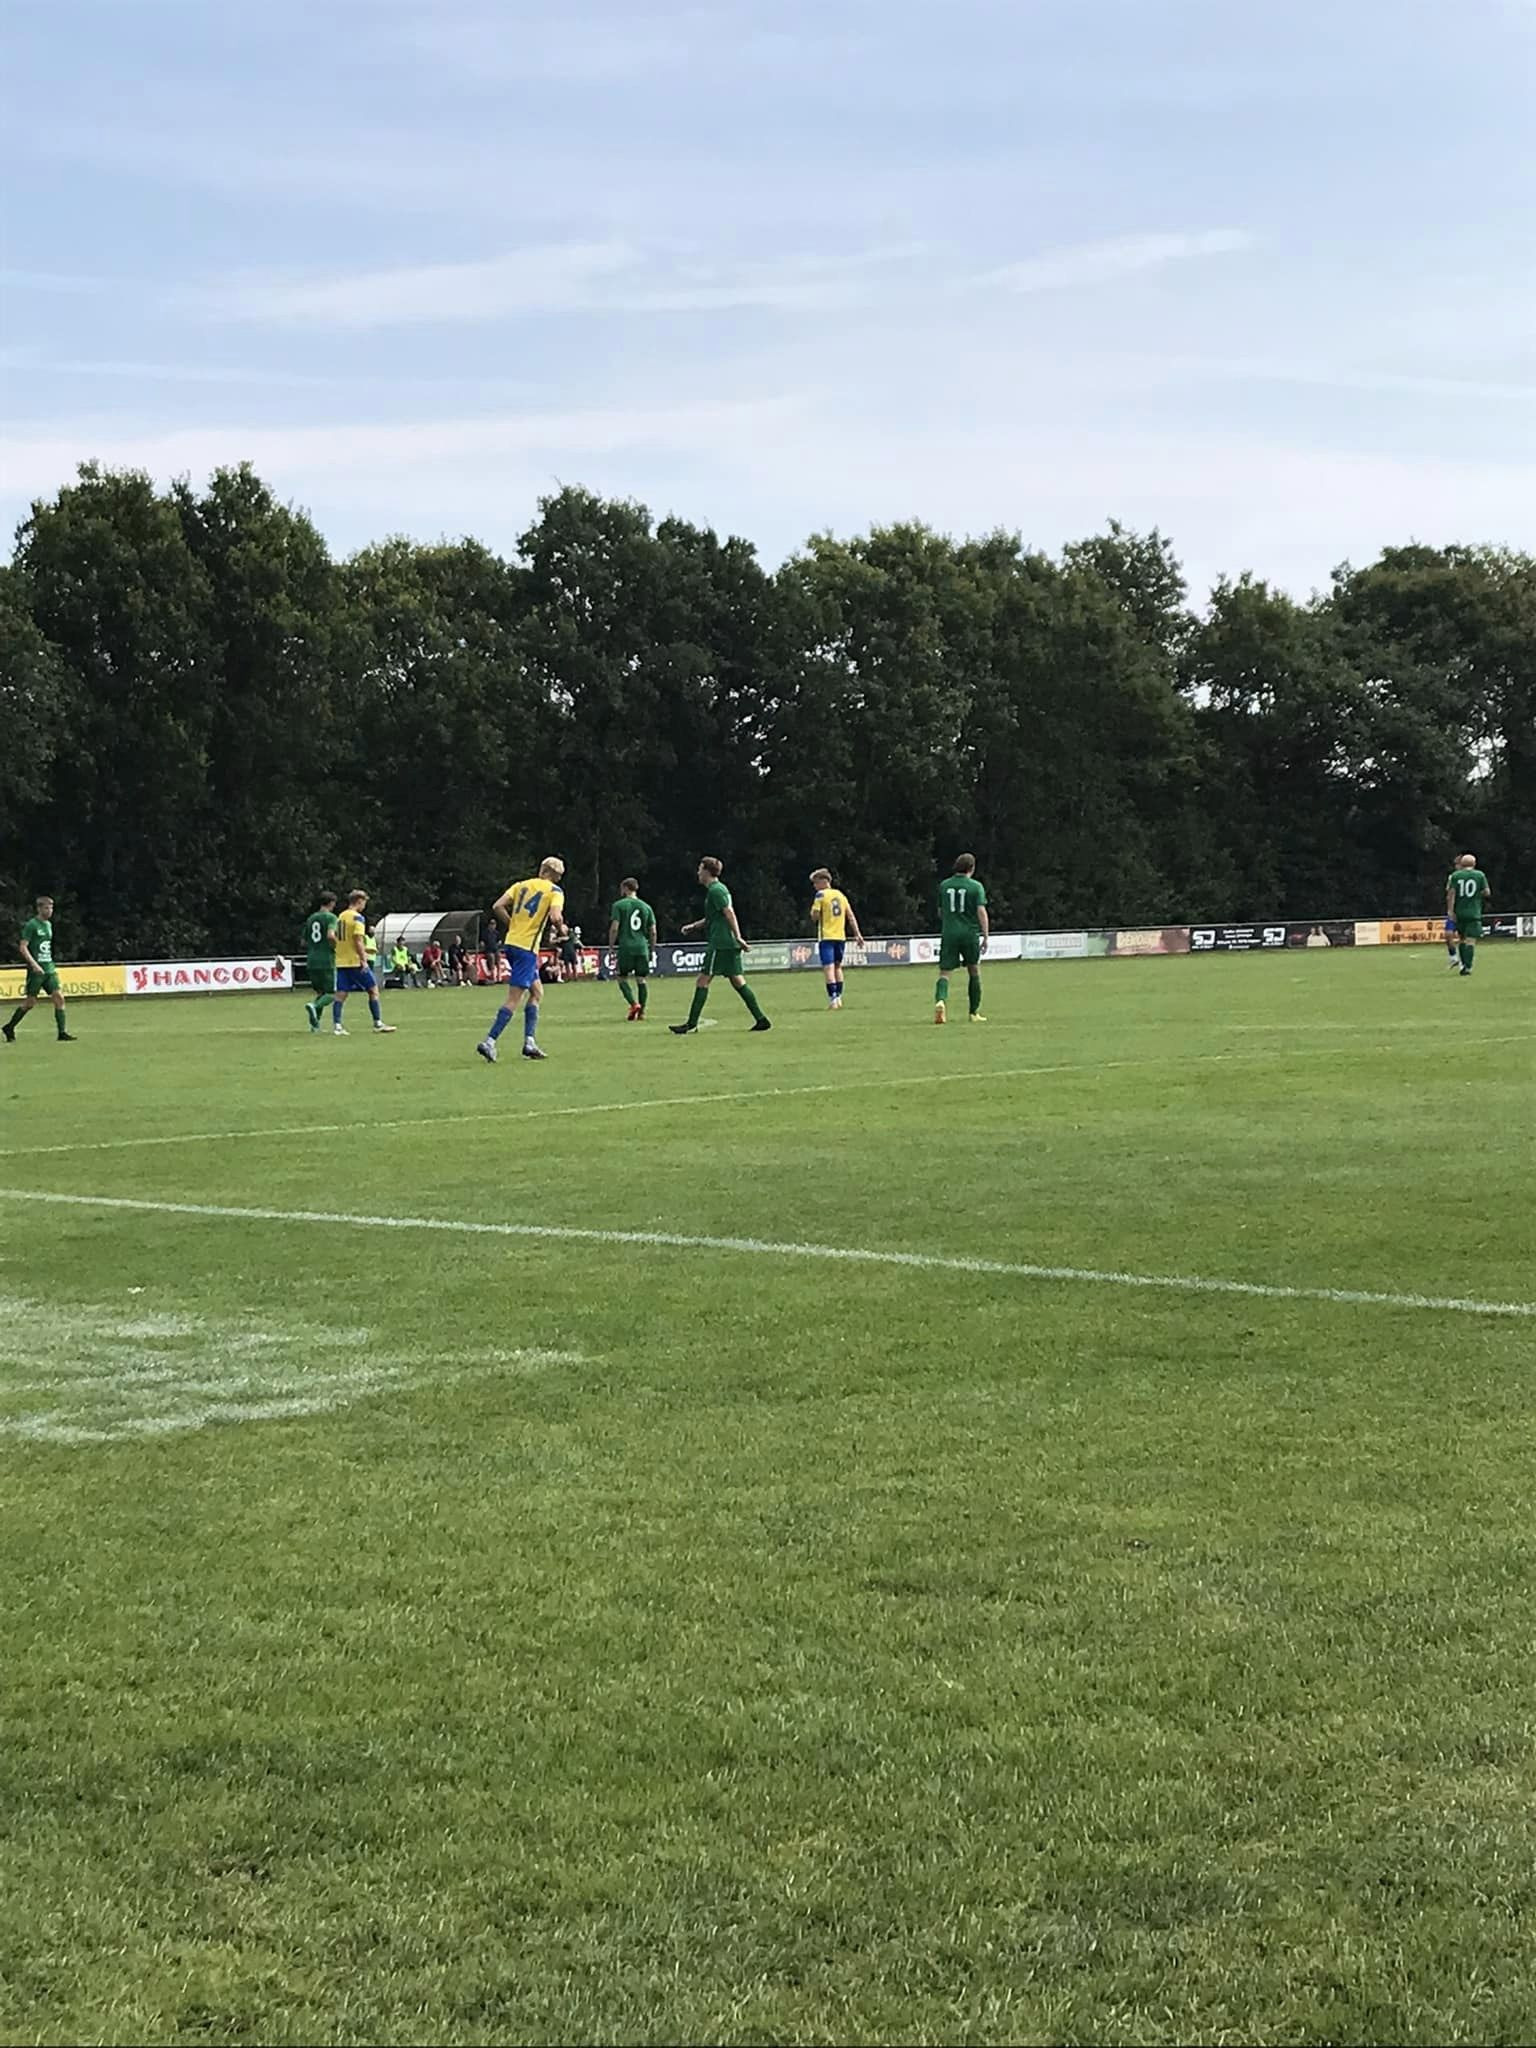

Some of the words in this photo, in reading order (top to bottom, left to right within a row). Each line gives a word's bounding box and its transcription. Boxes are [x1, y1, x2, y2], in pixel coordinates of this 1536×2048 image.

[1457, 879, 1477, 898] 10
[515, 887, 544, 919] 14
[831, 897, 842, 917] 8
[946, 887, 967, 913] 11
[630, 909, 642, 931] 6
[311, 921, 322, 943] 8
[153, 966, 286, 986] HANCOCK
